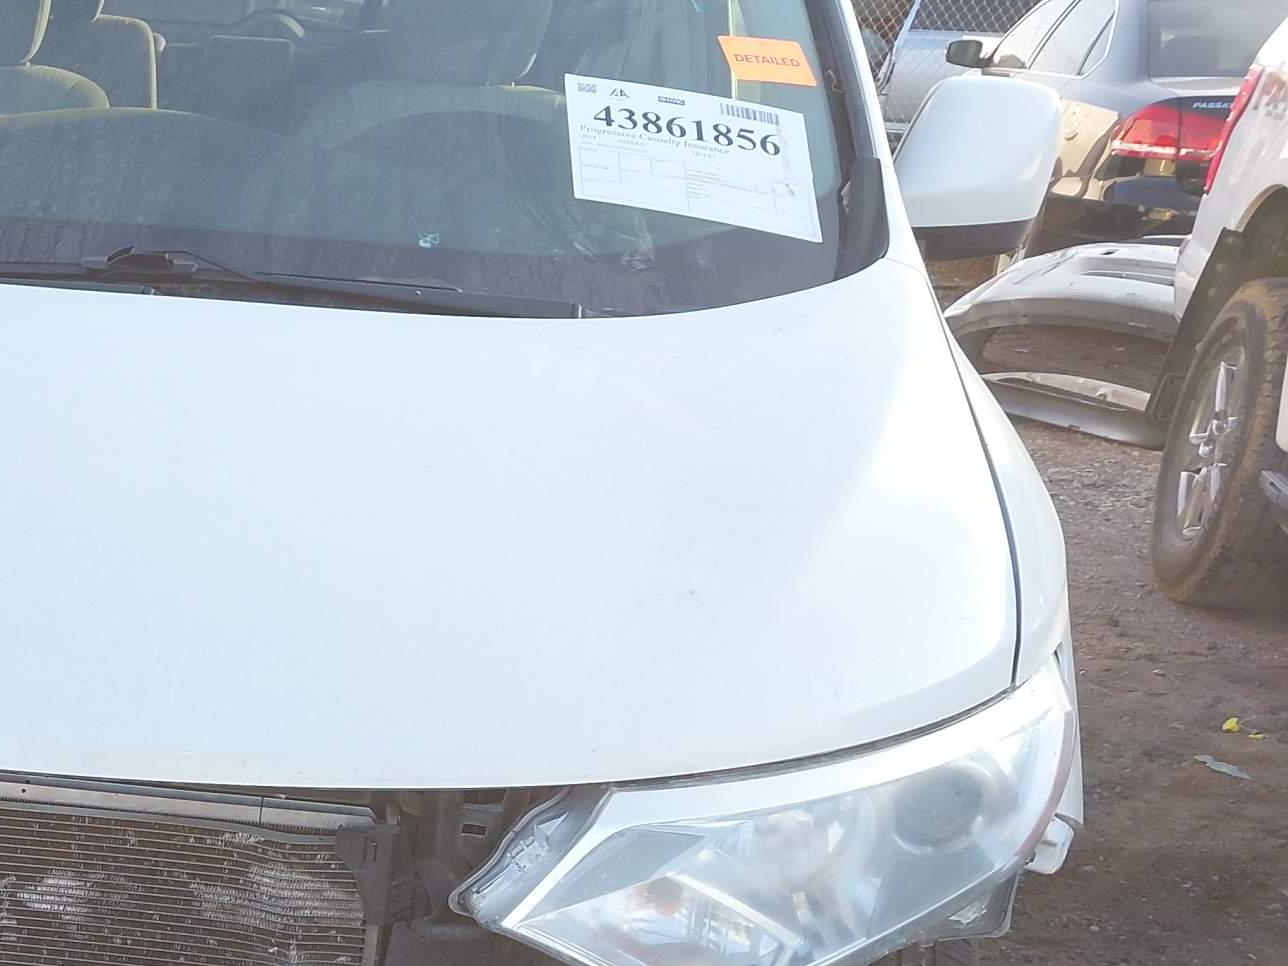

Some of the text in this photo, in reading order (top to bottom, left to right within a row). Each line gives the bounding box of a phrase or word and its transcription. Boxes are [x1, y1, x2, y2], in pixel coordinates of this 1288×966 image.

[734, 54, 800, 67] DETAILED
[579, 124, 638, 139] Progressive
[639, 133, 681, 148] Casualty
[684, 140, 730, 155] Insurance
[593, 105, 781, 156] 43861856
